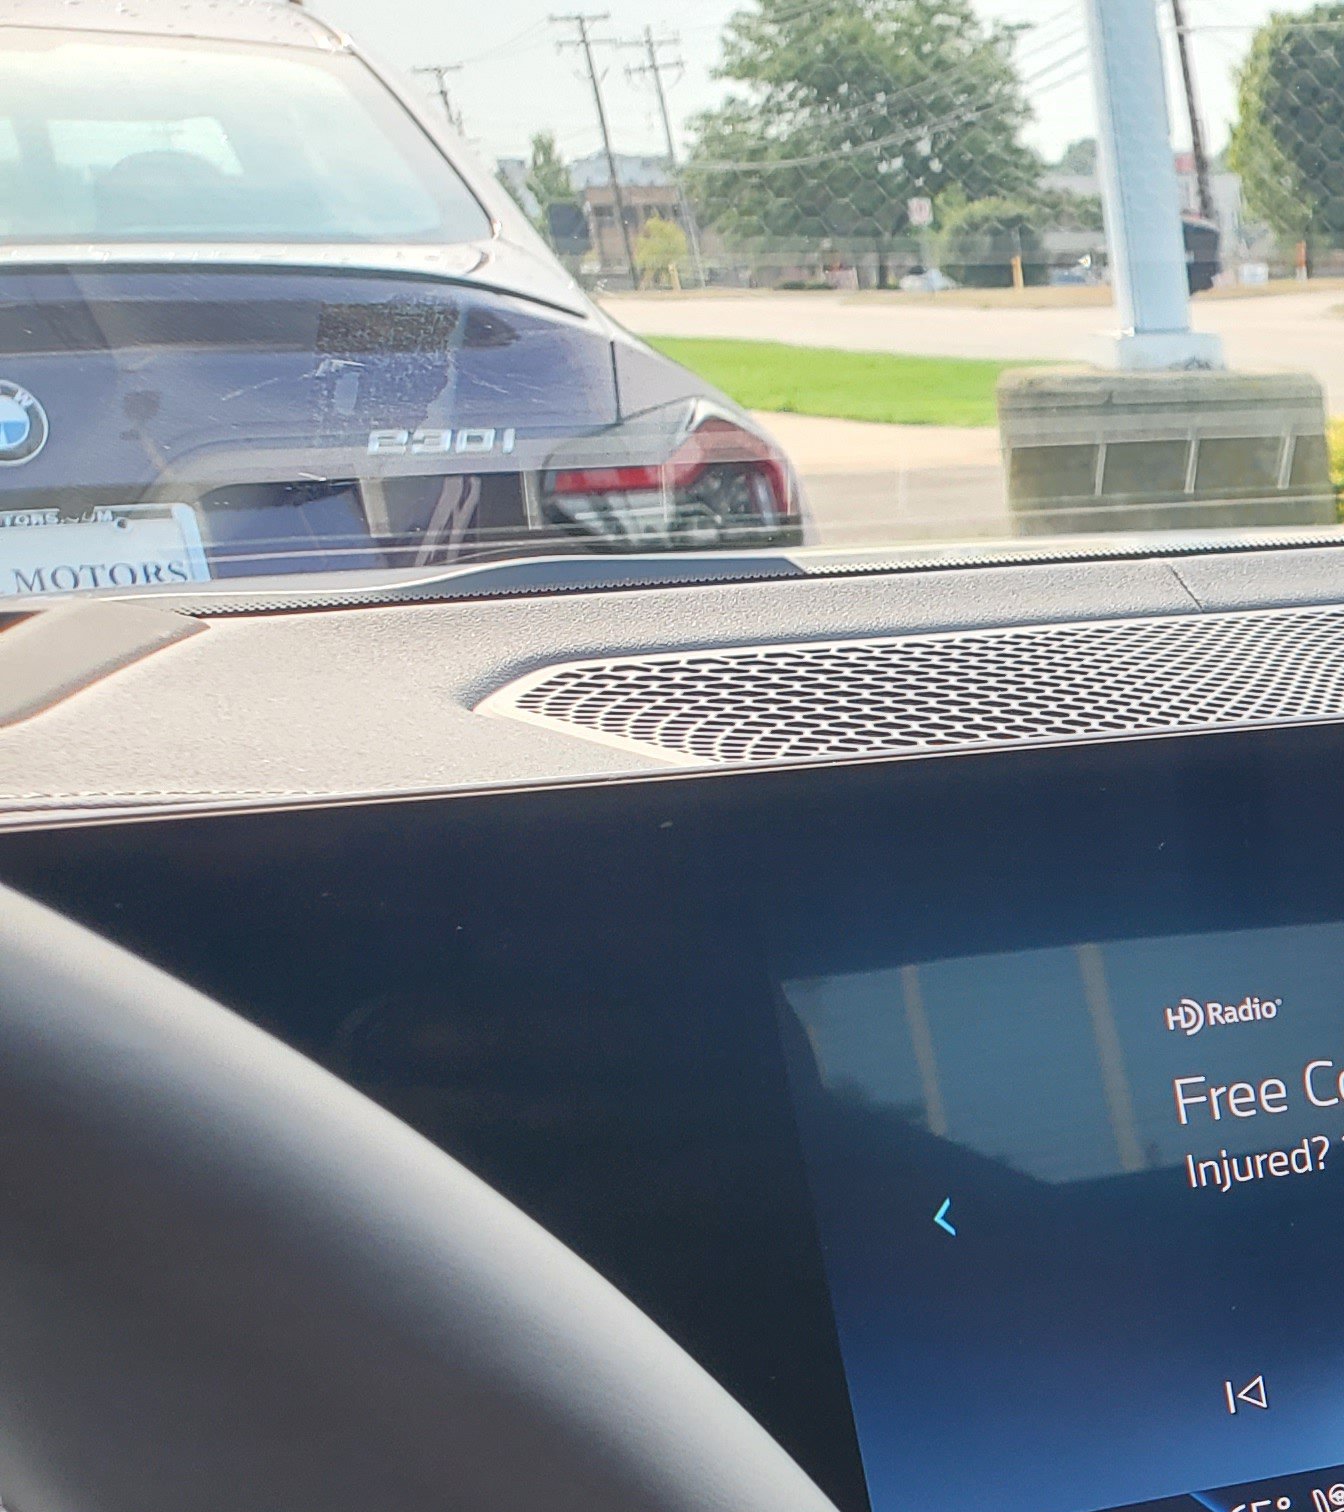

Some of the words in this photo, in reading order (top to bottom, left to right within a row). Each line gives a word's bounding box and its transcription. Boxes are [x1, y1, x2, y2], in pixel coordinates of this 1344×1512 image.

[12, 558, 190, 594] MOTORS
[1174, 1074, 1288, 1126] Free
[1185, 1135, 1331, 1193] Injured?
